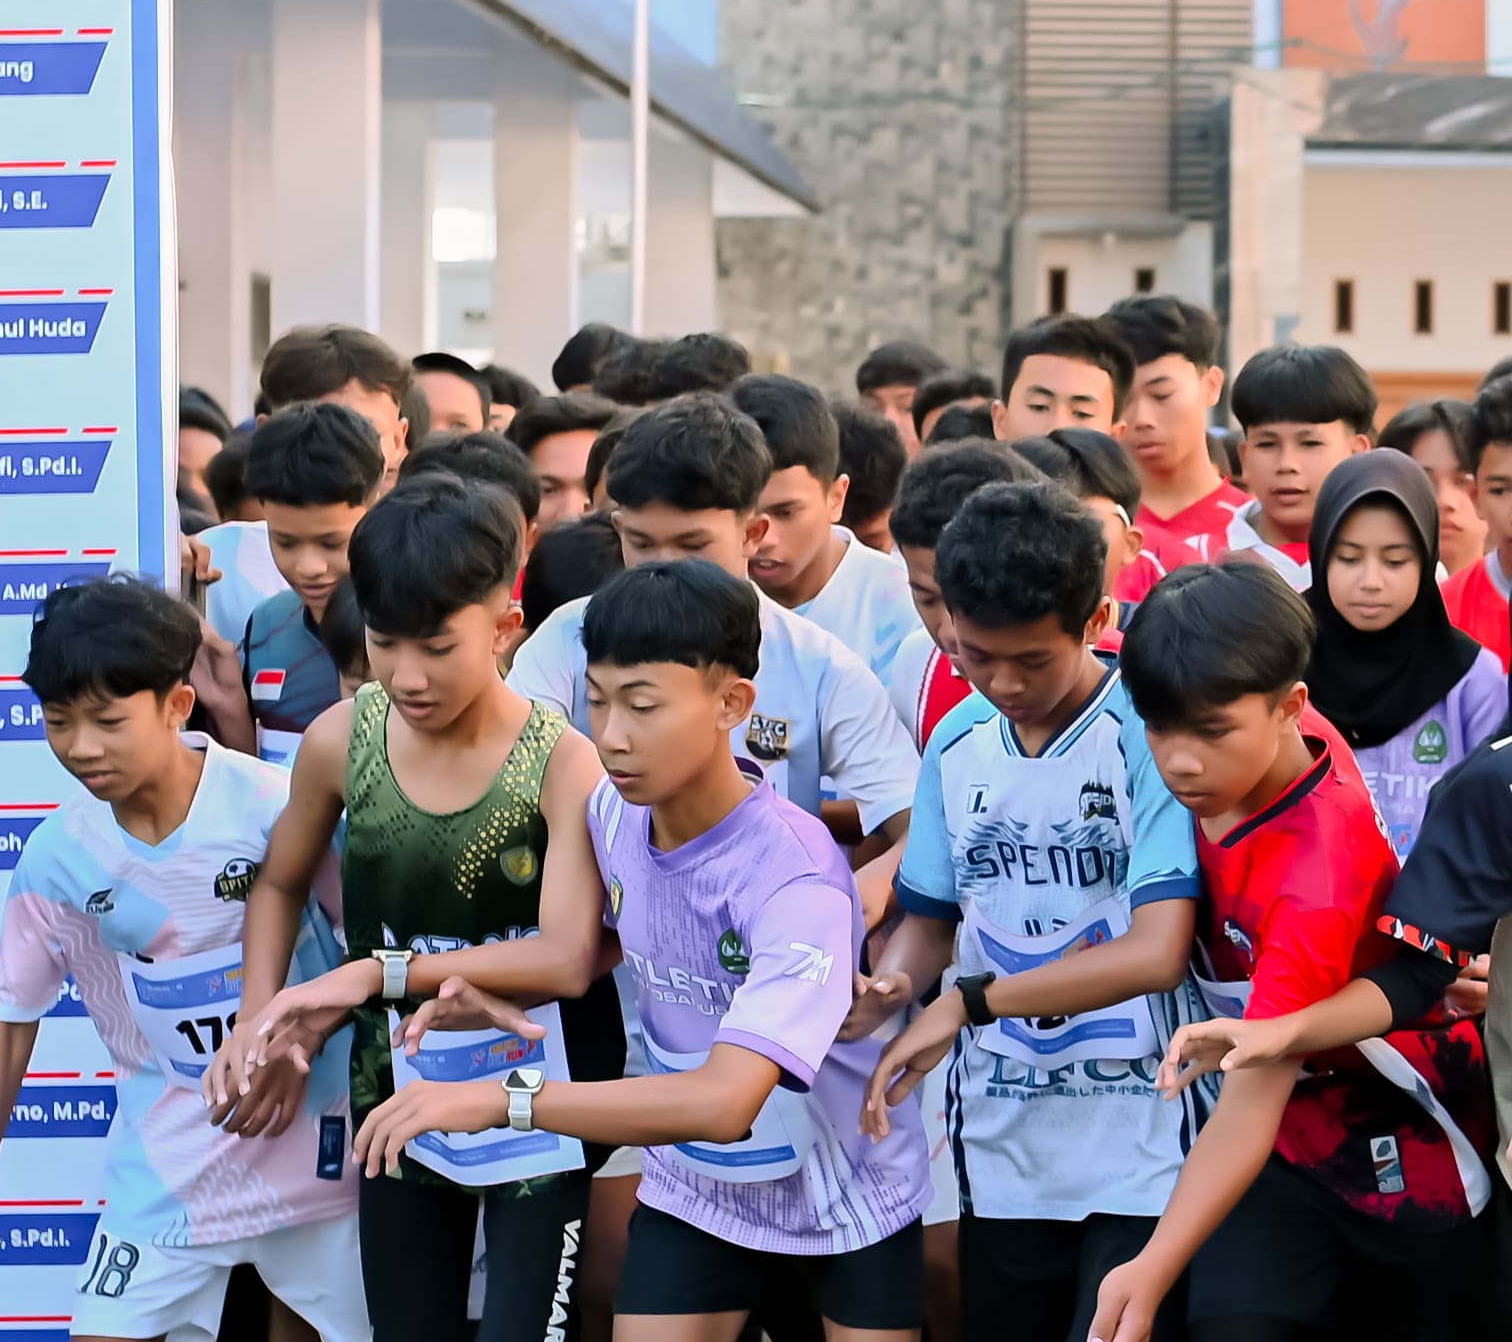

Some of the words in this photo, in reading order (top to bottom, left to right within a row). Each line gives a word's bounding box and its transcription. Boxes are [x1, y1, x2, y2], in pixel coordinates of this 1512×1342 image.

[29, 318, 86, 340] Huda
[10, 703, 44, 727] S.P
[175, 1012, 237, 1055] 17
[53, 1102, 110, 1121] M.Pd.
